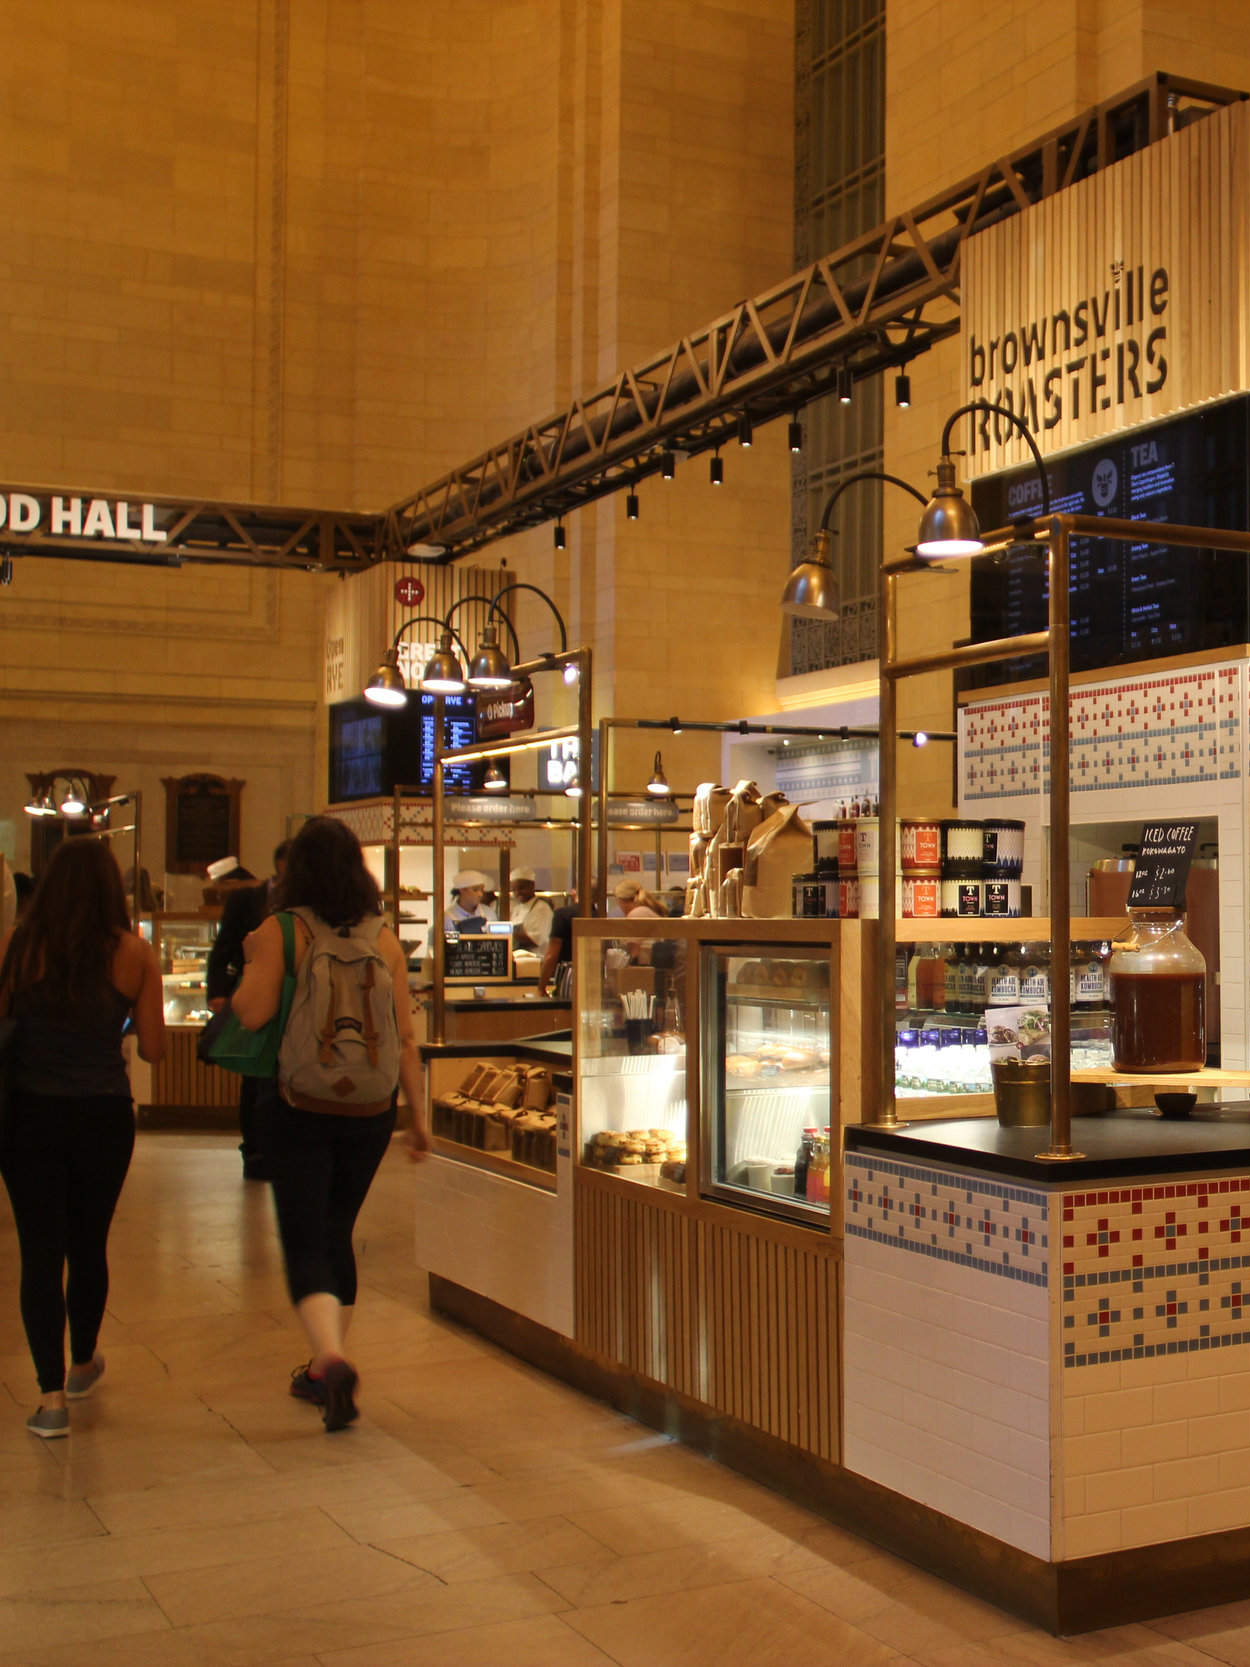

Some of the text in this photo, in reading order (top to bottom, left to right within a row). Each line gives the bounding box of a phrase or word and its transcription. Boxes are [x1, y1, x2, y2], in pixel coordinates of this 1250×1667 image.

[970, 262, 1169, 387] brownsville
[970, 326, 1168, 456] ROASTERS
[1131, 440, 1158, 468] TEA
[0, 493, 168, 541] D HALL
[445, 695, 463, 705] RYE
[493, 701, 514, 719] Pickup
[452, 802, 530, 814] Please order here
[629, 807, 652, 816] order
[653, 807, 672, 816] here
[1144, 826, 1194, 842] ICED COFFEE
